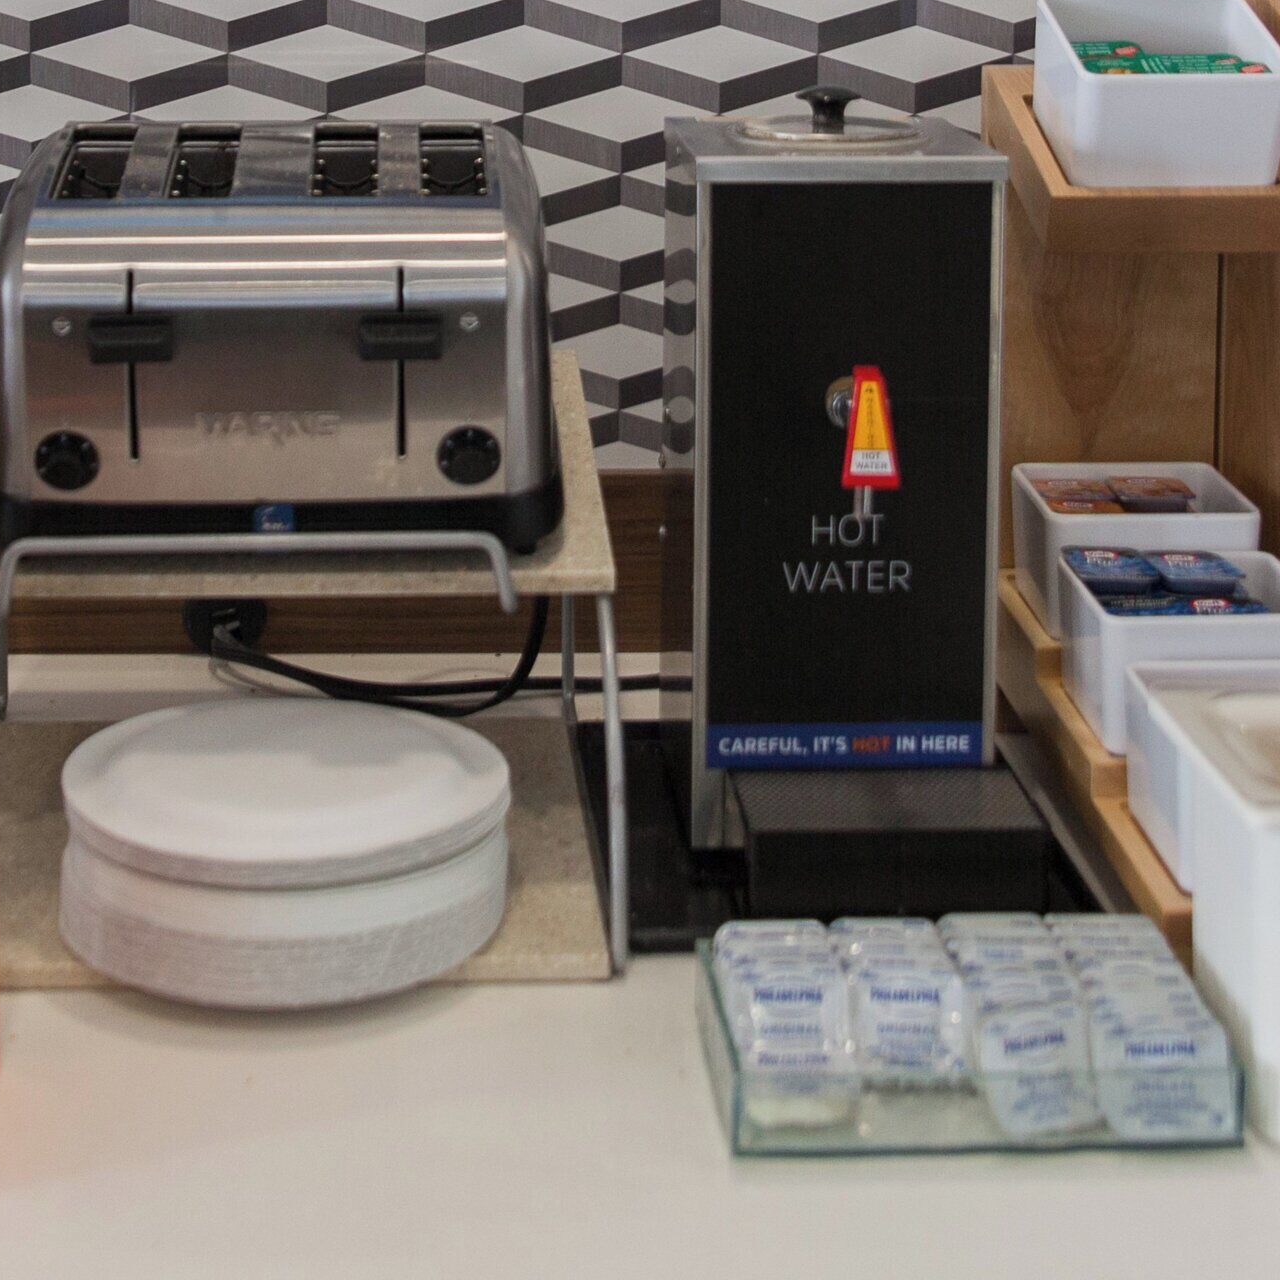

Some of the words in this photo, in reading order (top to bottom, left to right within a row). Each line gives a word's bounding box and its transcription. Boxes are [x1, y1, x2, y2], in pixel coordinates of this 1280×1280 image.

[854, 461, 888, 470] WATER
[861, 451, 881, 460] HOT
[811, 513, 884, 547] HOT
[782, 560, 912, 593] WATER
[719, 736, 808, 756] CAREFUL,
[813, 736, 847, 753] IT'S
[852, 736, 890, 753] HOT
[896, 735, 915, 752] IN
[921, 735, 970, 753] HERE
